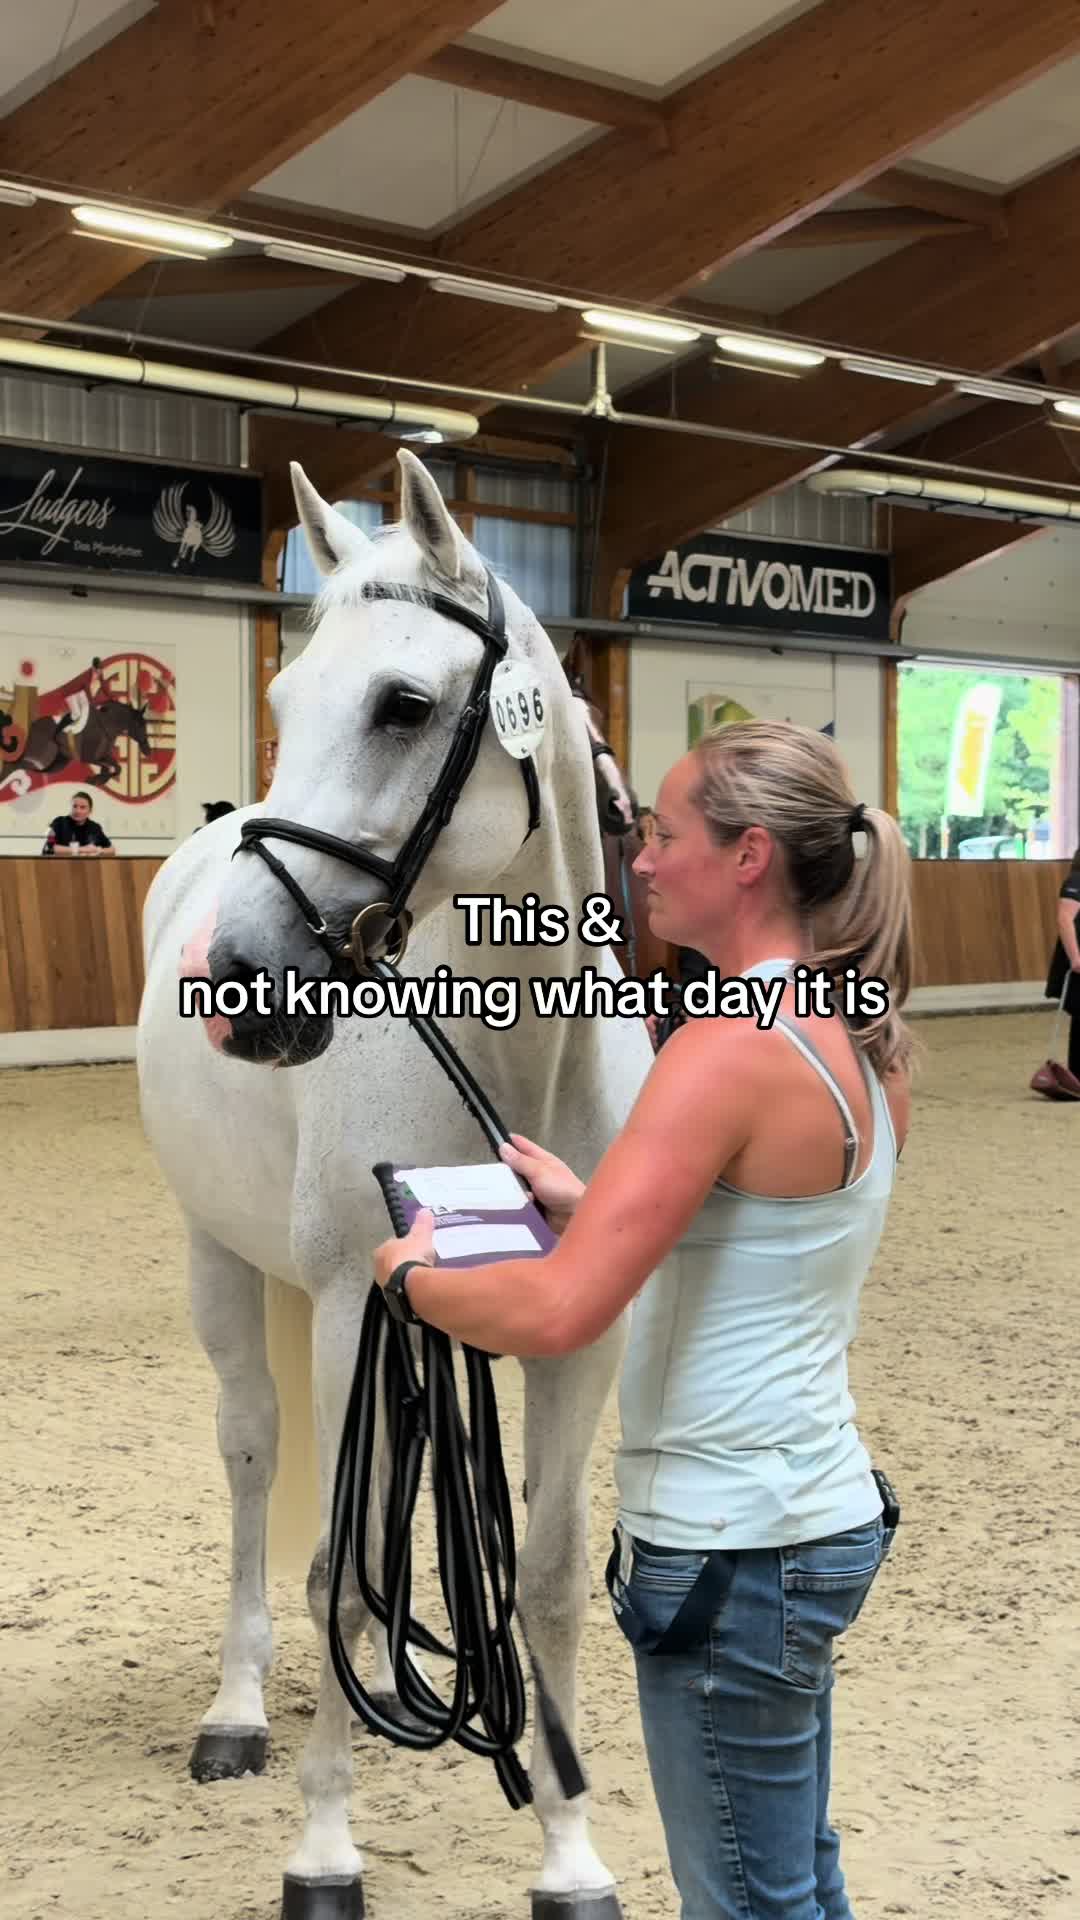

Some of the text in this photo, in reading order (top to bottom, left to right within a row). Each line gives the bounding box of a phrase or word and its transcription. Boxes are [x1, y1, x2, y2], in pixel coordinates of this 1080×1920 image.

[0, 466, 115, 556] Ludgers
[646, 550, 876, 617] ACTIVOMED
[496, 688, 543, 733] 0696
